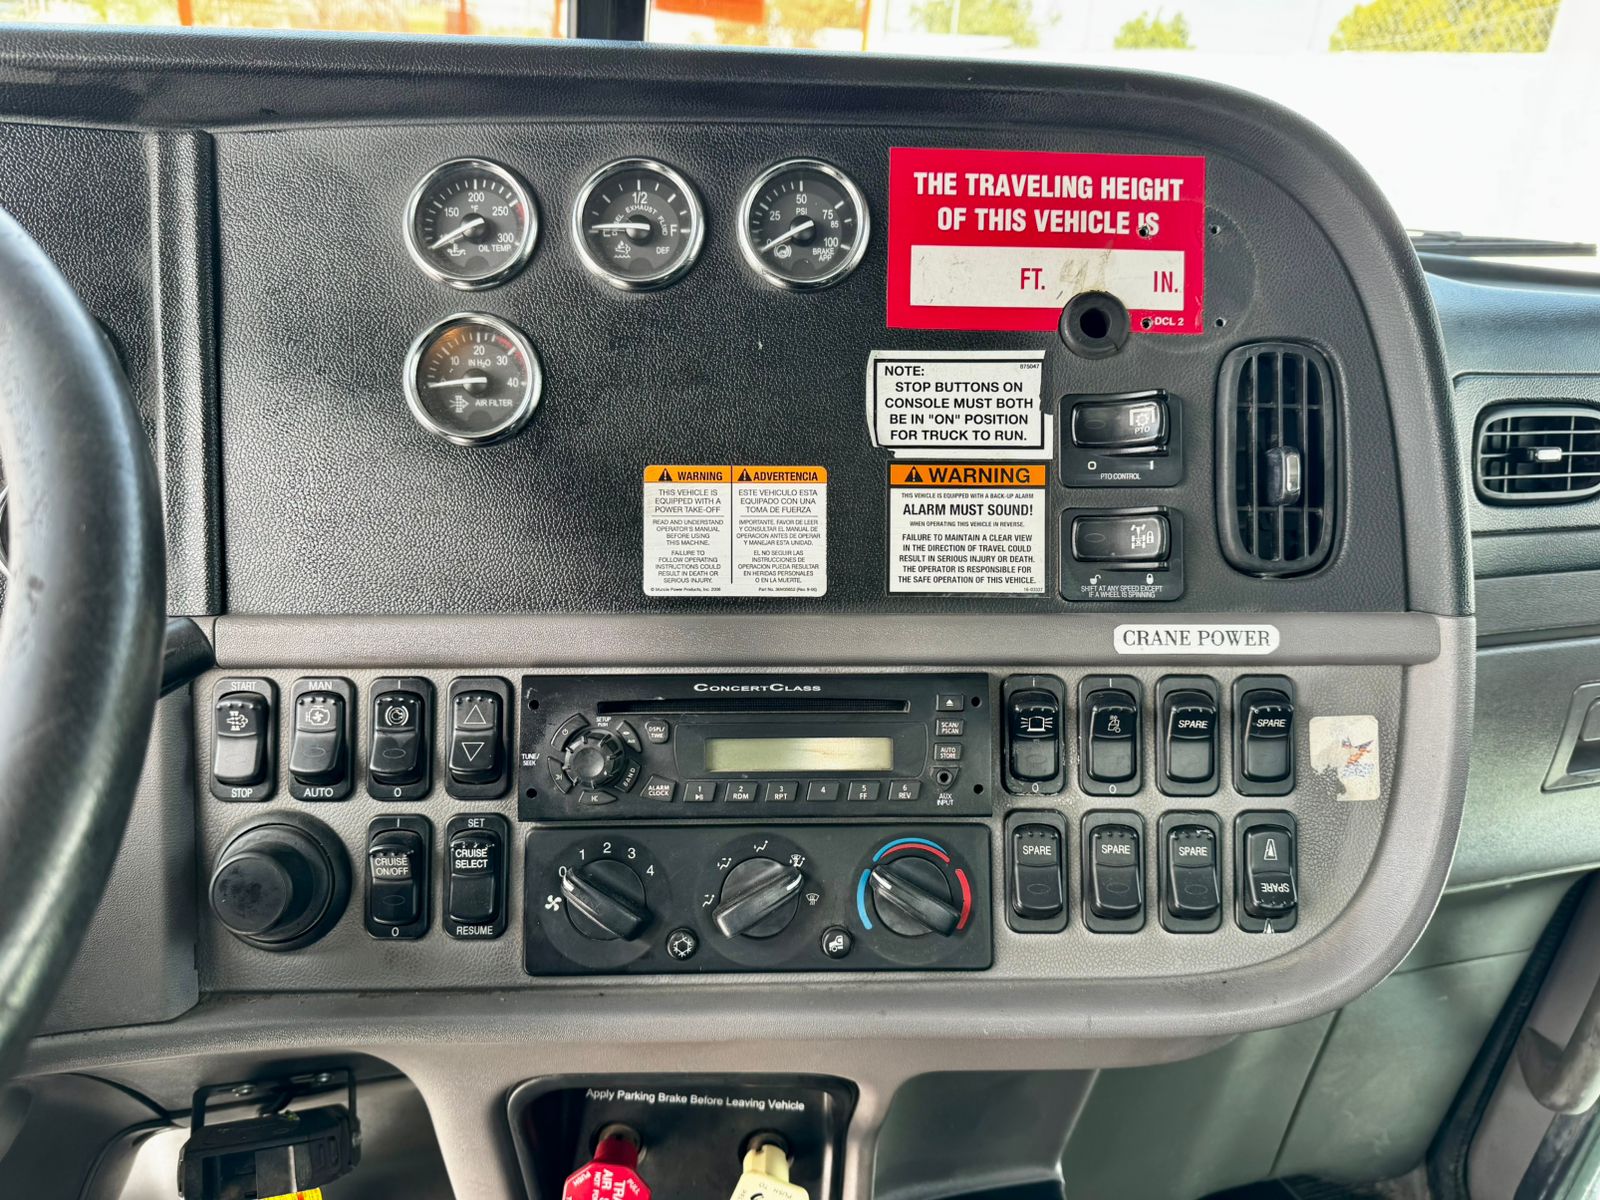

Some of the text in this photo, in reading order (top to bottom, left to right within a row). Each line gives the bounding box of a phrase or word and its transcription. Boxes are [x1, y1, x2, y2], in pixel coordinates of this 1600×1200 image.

[914, 172, 1184, 201] THE TRAVELING HEIGHT
[468, 192, 485, 202] 200
[632, 192, 648, 204] 1/2
[796, 194, 807, 204] 50
[444, 207, 460, 217] 150
[492, 206, 509, 217] 250
[625, 205, 657, 214] EXHAUST
[770, 211, 780, 220] 25
[822, 210, 834, 220] 75
[938, 207, 1160, 236] OF THIS VEHICLE IS
[670, 224, 678, 237] F
[497, 233, 515, 243] 300
[824, 238, 838, 247] 100
[478, 244, 512, 252] OIL TEMP
[656, 246, 670, 254] DEF
[1020, 268, 1178, 293] FT. IN.
[1154, 317, 1184, 326] DCL 2
[473, 346, 485, 356] 20
[451, 356, 460, 366] 10
[496, 356, 508, 366] 30
[885, 366, 924, 376] NOTE:
[507, 378, 518, 387] 40
[896, 382, 1022, 392] STOP BUTTONS ON
[885, 398, 1033, 408] CONSOLE MUST BOTH
[890, 414, 1028, 424] BE IN "ON" POSITION
[891, 430, 1026, 440] FOR TRUCK TO RUN.
[1134, 426, 1150, 434] PTO
[678, 472, 722, 480] WARNING
[754, 472, 818, 481] ADVERTENCIA
[929, 468, 1030, 483] WARNING
[903, 504, 1033, 516] ALARM MUST SOUND!
[1123, 630, 1270, 646] CRANE POWER
[231, 682, 256, 690] START
[1178, 720, 1208, 729] SPARE
[1256, 719, 1286, 728] SPARE
[624, 767, 636, 786] BAND
[232, 788, 252, 798] STOP
[304, 788, 334, 797] AUTO
[468, 819, 485, 828] SET
[603, 843, 611, 853] 2
[1022, 845, 1052, 855] SPARE
[1102, 845, 1130, 854] SPARE
[1179, 846, 1208, 856] SPARE
[455, 849, 487, 858] CRUISE
[579, 850, 585, 860] 1
[628, 848, 636, 859] 3
[455, 860, 488, 868] SELECT
[376, 867, 408, 876] ON/OFF
[646, 865, 655, 876] 4
[1261, 882, 1290, 892] SPARE
[457, 926, 493, 935] RESUME
[586, 1088, 805, 1111] Apply Parking Brake Before Leaving Vehicle
